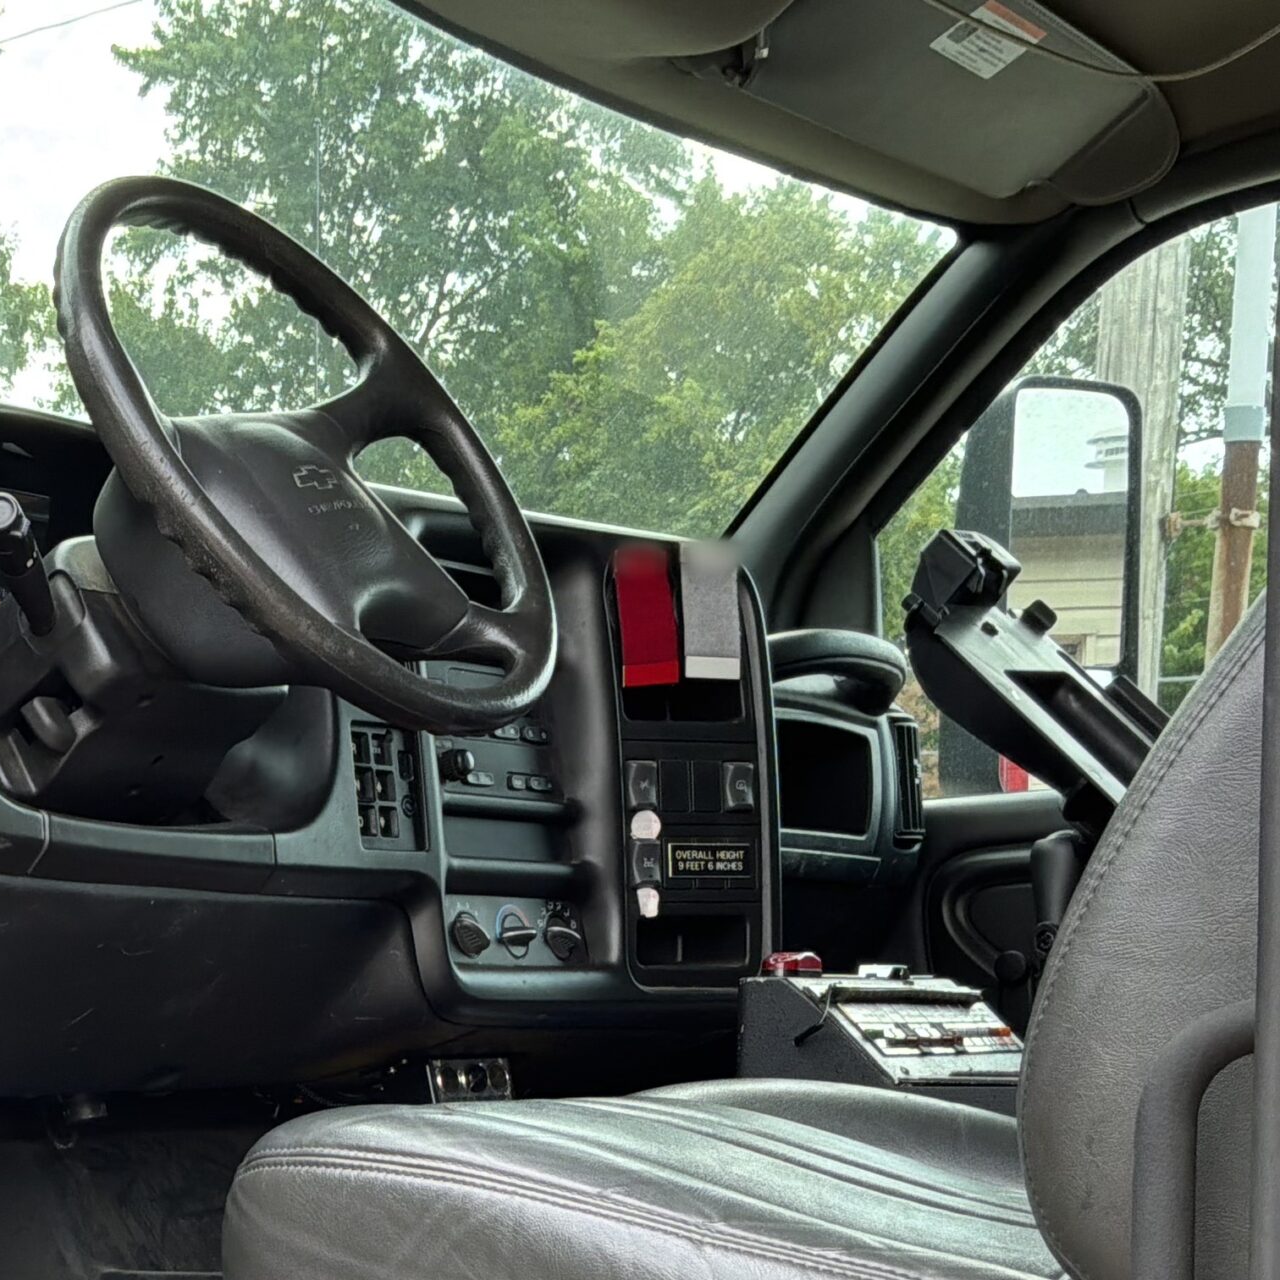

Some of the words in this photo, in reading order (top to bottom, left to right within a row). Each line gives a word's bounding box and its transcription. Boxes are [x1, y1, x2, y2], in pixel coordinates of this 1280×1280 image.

[675, 849, 714, 860] OVERALL
[715, 850, 745, 860] HEIGHT
[677, 861, 685, 871] 9
[685, 861, 706, 871] FEET
[707, 861, 714, 871] 6
[715, 861, 744, 871] INCHES
